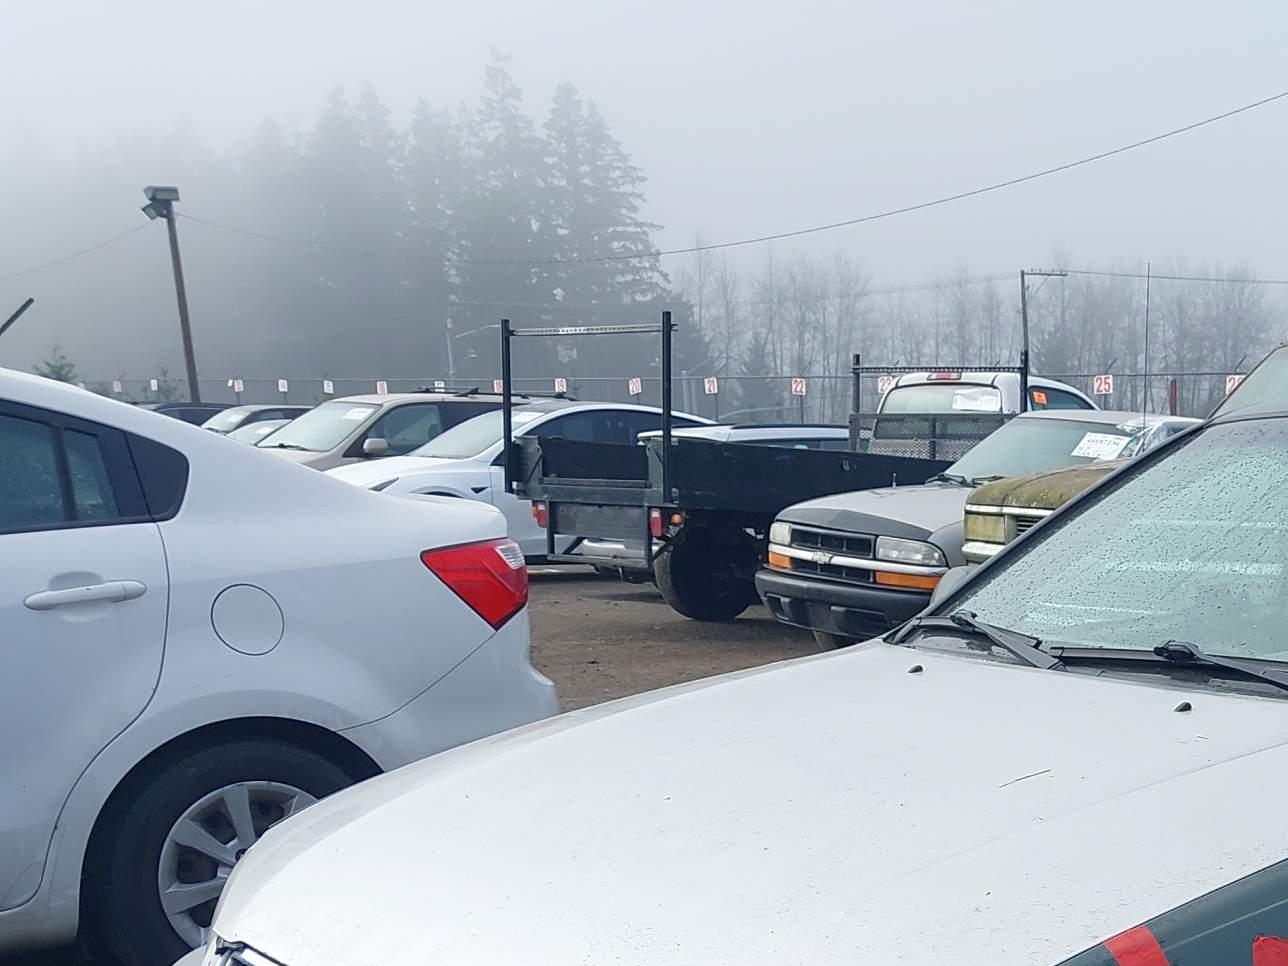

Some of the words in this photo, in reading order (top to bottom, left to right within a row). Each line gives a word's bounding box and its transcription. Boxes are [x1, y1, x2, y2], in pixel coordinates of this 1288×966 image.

[556, 378, 565, 392] 19
[629, 378, 640, 393] 20
[706, 378, 716, 393] 21
[793, 378, 804, 393] 22
[1095, 376, 1111, 393] 25
